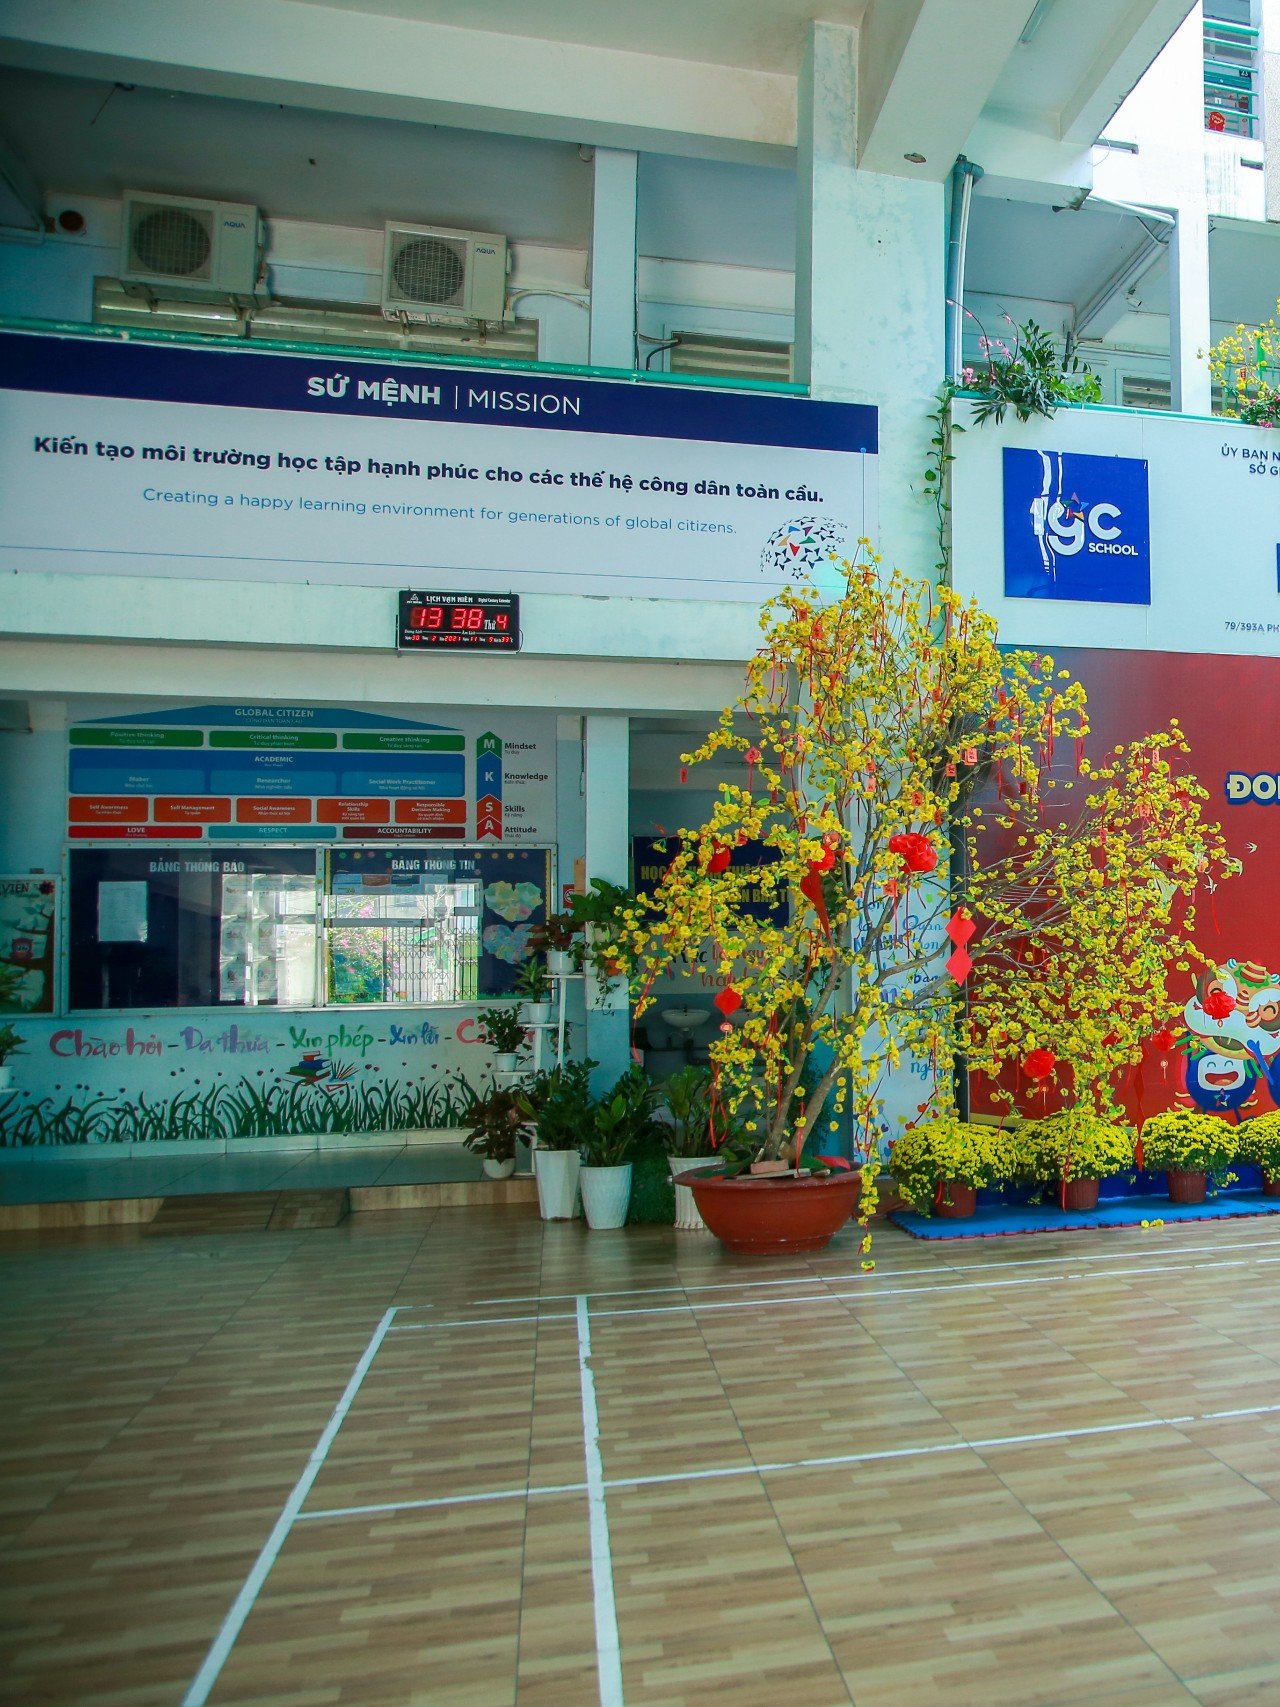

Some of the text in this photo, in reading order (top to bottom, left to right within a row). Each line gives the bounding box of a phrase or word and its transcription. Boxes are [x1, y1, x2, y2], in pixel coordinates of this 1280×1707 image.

[223, 221, 246, 229] AQUA
[475, 247, 496, 255] AQUA
[307, 373, 582, 417] SỨ MỆNH MISSION
[1221, 443, 1239, 457] ỦY
[1242, 449, 1269, 460] BAN
[34, 435, 824, 504] Kiến tạo môi trường học tập hạnh phúc cho các thế hệ công dân toàn cầu.
[1249, 461, 1266, 474] SỞ
[142, 487, 737, 535] Creating a happy learning environment for generations of global citizens.
[1088, 542, 1139, 556] SCHOOL
[427, 595, 441, 604] LỊCH
[442, 596, 456, 604] VẠN
[420, 607, 484, 629] 13 38
[496, 615, 508, 630] 4
[1224, 621, 1266, 633] 79/393A
[234, 708, 314, 718] GLOBAL CITIZEN
[484, 739, 495, 749] M
[485, 772, 494, 782] K
[504, 773, 549, 782] Knowledge
[485, 802, 494, 812] S
[504, 805, 526, 813] Skills
[484, 820, 494, 830] A
[149, 857, 245, 873] BẢNG THÔNG BÁO
[391, 855, 475, 871] BẢNG THÔNG TIN
[49, 1028, 121, 1058] Chào
[126, 1027, 163, 1056] hỏi
[179, 1026, 214, 1055] Dạ
[216, 1024, 271, 1054] thưa
[289, 1025, 323, 1049] Xin
[325, 1024, 374, 1057] phép
[389, 1024, 418, 1046] Xin
[420, 1021, 440, 1046] lỗi
